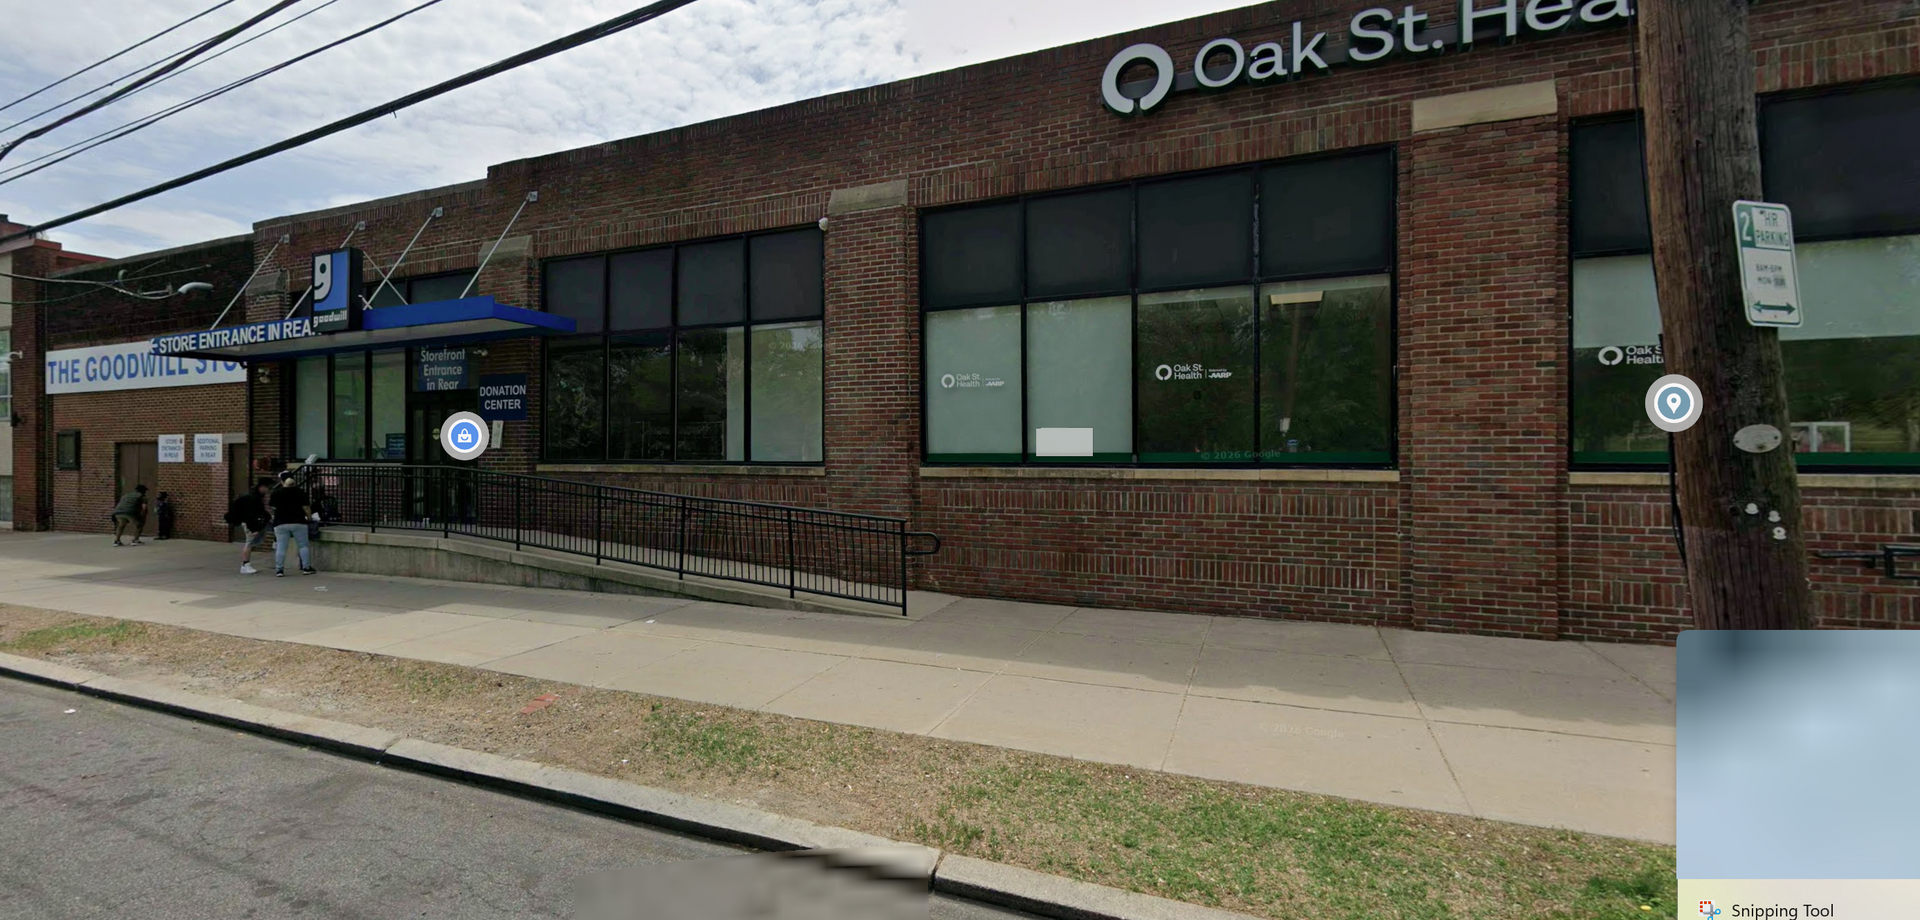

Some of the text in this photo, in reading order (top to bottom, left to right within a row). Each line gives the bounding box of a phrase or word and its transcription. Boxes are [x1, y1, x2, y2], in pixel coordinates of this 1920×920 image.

[1194, 21, 1328, 88] Oak
[1348, 7, 1445, 63] St.
[1740, 211, 1752, 241] 2
[1765, 212, 1778, 226] HR
[1755, 229, 1789, 247] PARKING
[313, 309, 347, 328] goodwill
[160, 319, 318, 354] STORE ENTRANCE IN REA
[421, 349, 466, 362] Storefront
[1625, 345, 1653, 355] Oak
[48, 359, 81, 384] THE
[423, 364, 462, 376] Entrance
[426, 378, 459, 391] in Rear
[480, 385, 526, 397] DONATION
[484, 399, 521, 410] CENTER
